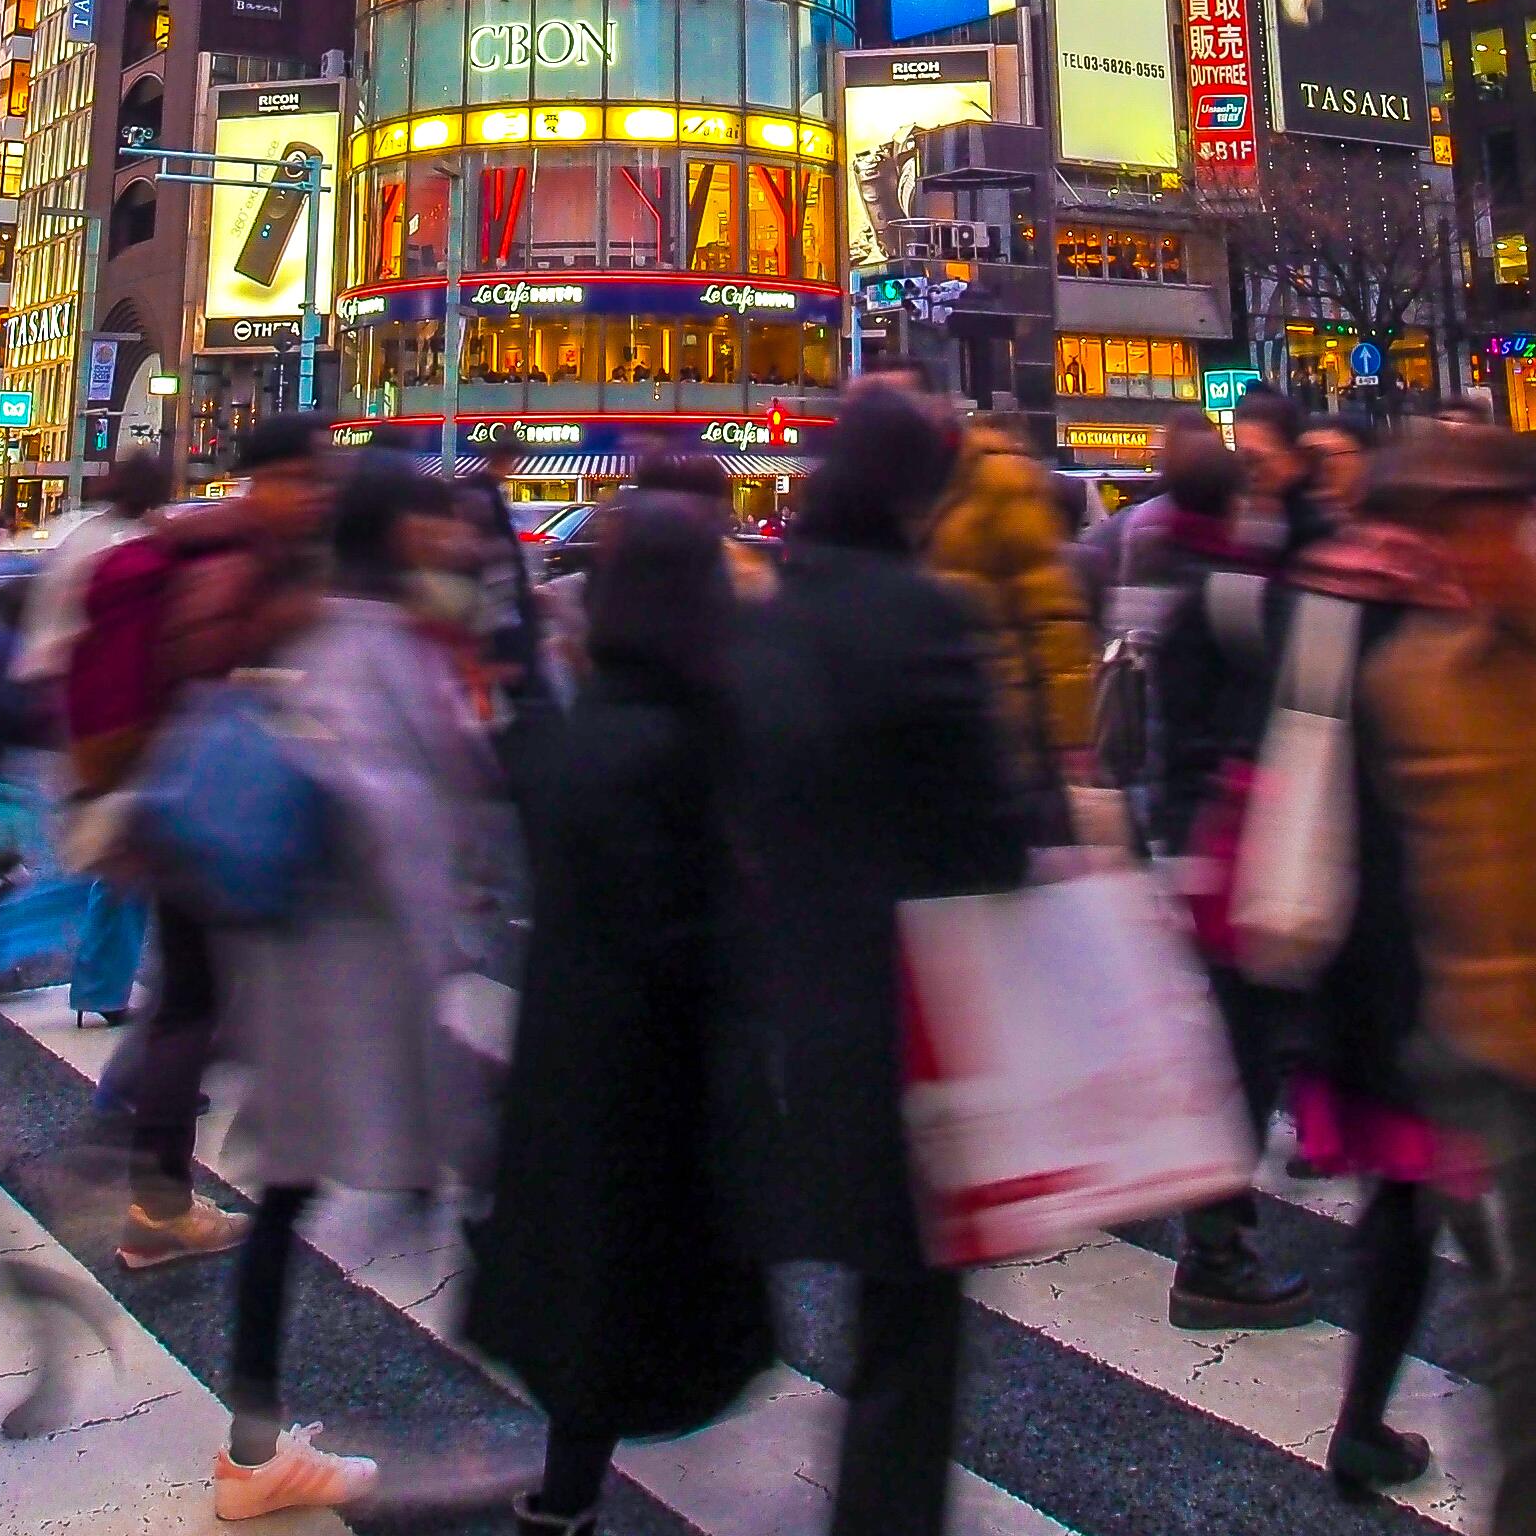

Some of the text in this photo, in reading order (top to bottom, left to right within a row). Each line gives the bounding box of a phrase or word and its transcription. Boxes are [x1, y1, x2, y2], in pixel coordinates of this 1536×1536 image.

[469, 21, 617, 69] C'BON
[1189, 22, 1245, 61] 販売
[892, 60, 941, 74] RICOH
[1062, 52, 1165, 79] TEL03-5826-0555
[1190, 62, 1248, 88] DUTYFREE
[257, 93, 300, 106] RICOH
[1299, 81, 1413, 123] TASAKI
[1215, 140, 1254, 161] B1F
[471, 284, 492, 304] Le
[492, 281, 531, 311] Café
[699, 284, 721, 304] Le
[721, 284, 757, 314] Café
[7, 302, 71, 350] TASAKI
[253, 320, 300, 338] THA
[701, 421, 723, 442] Le
[723, 421, 757, 452] Café
